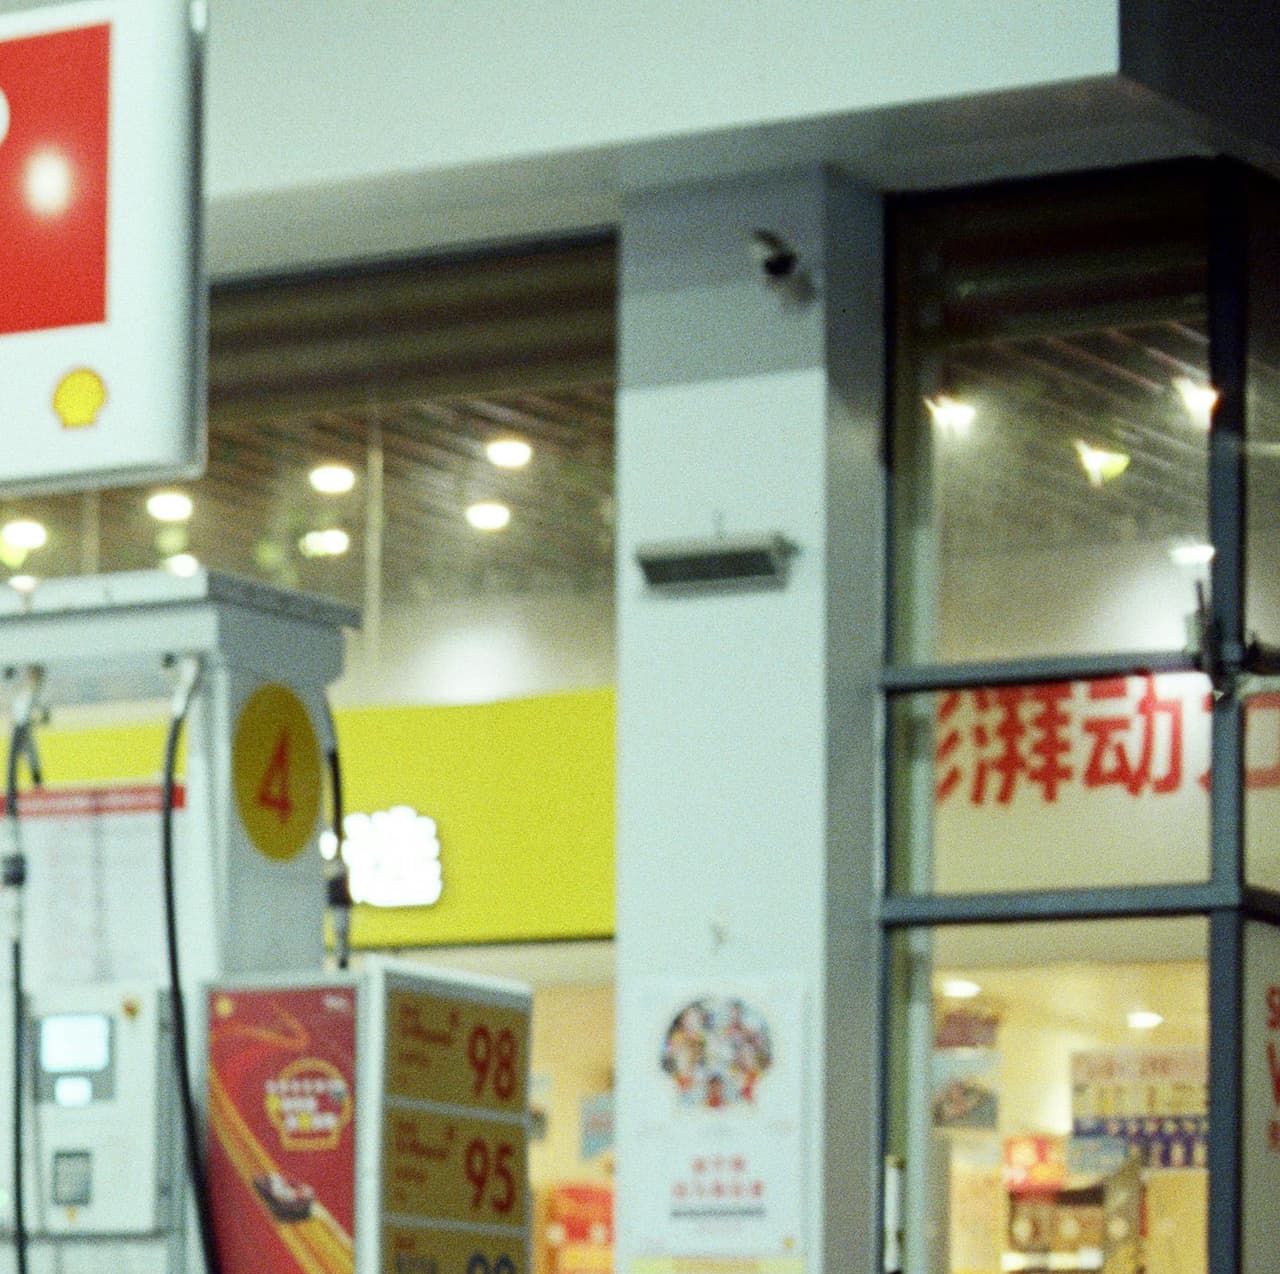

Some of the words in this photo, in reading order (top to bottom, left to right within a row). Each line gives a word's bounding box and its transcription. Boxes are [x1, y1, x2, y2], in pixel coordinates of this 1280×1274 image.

[258, 725, 293, 824] 4
[467, 1025, 517, 1100] 98
[464, 1138, 514, 1214] 95
